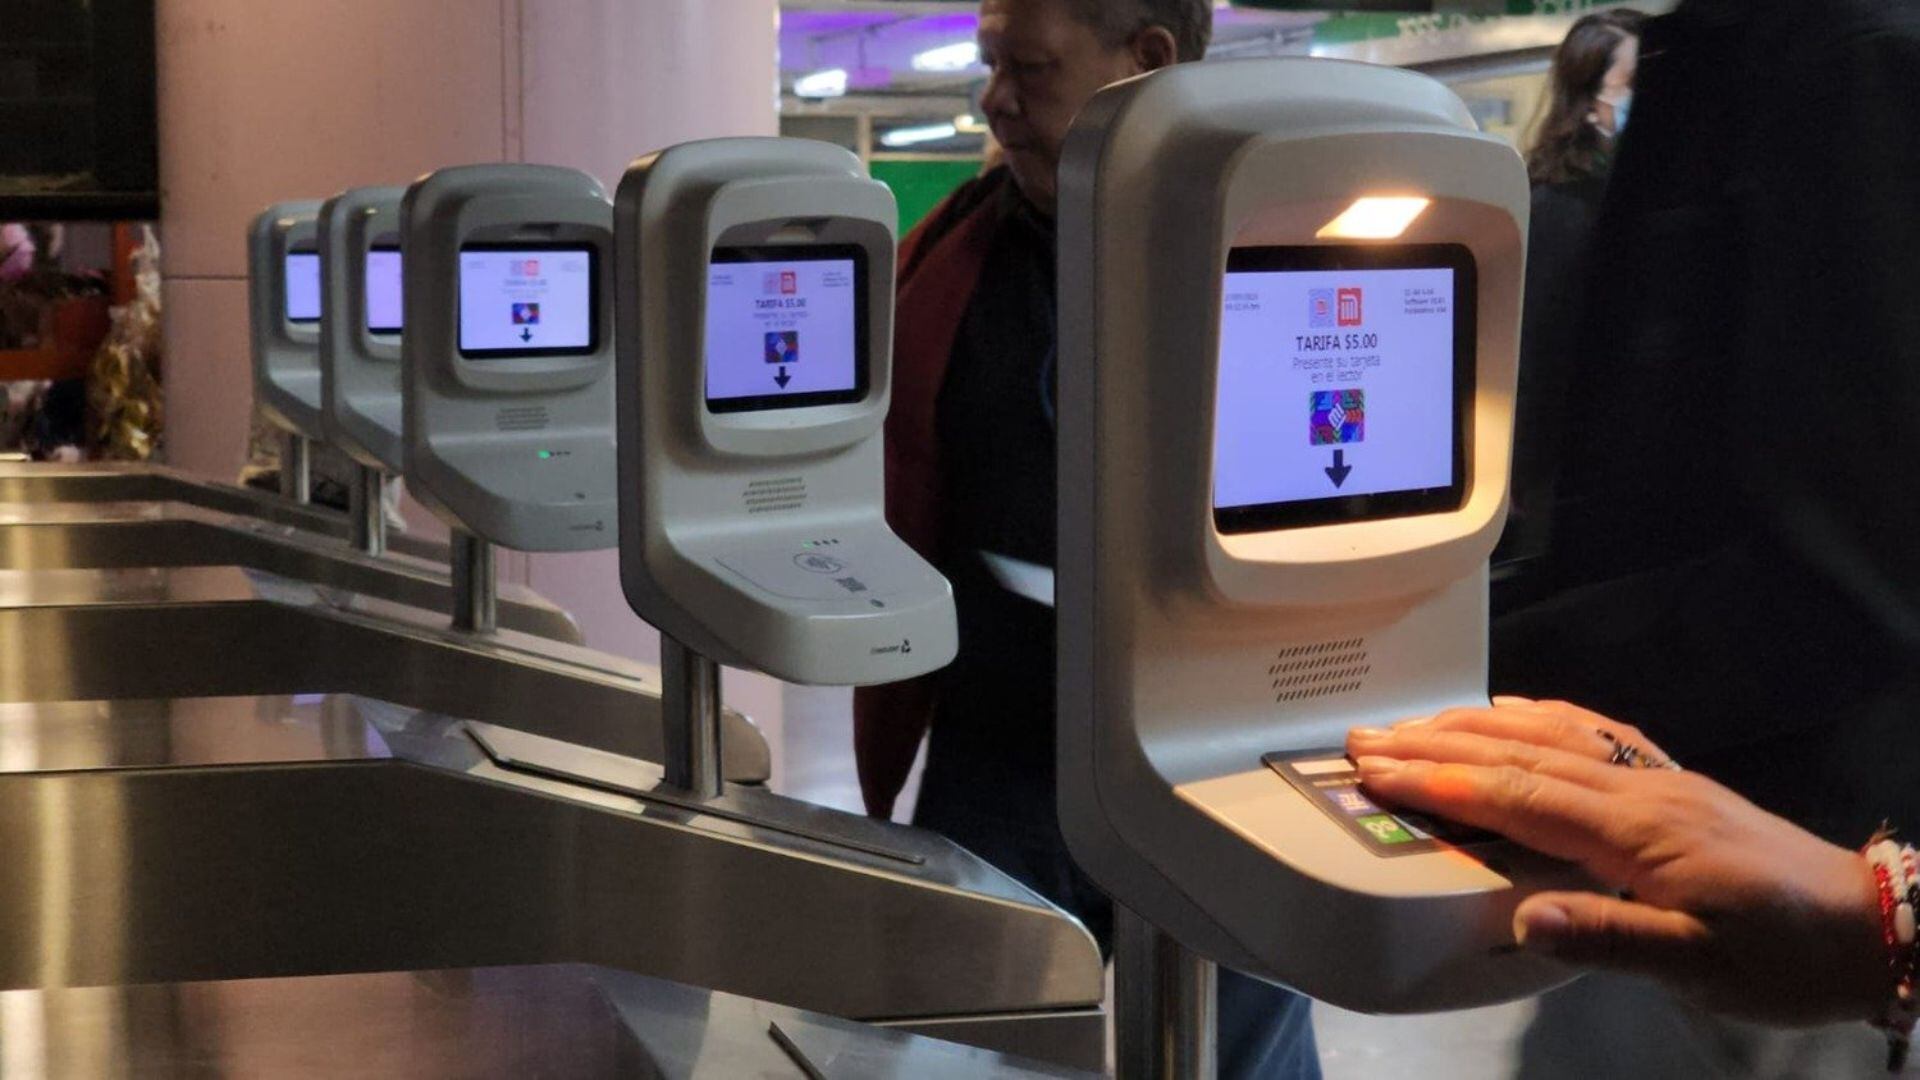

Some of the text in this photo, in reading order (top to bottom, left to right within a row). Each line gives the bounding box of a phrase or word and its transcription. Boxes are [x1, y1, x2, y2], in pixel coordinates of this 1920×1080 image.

[1296, 333, 1378, 351] TARIFA $5.00
[1292, 357, 1334, 370] Presente
